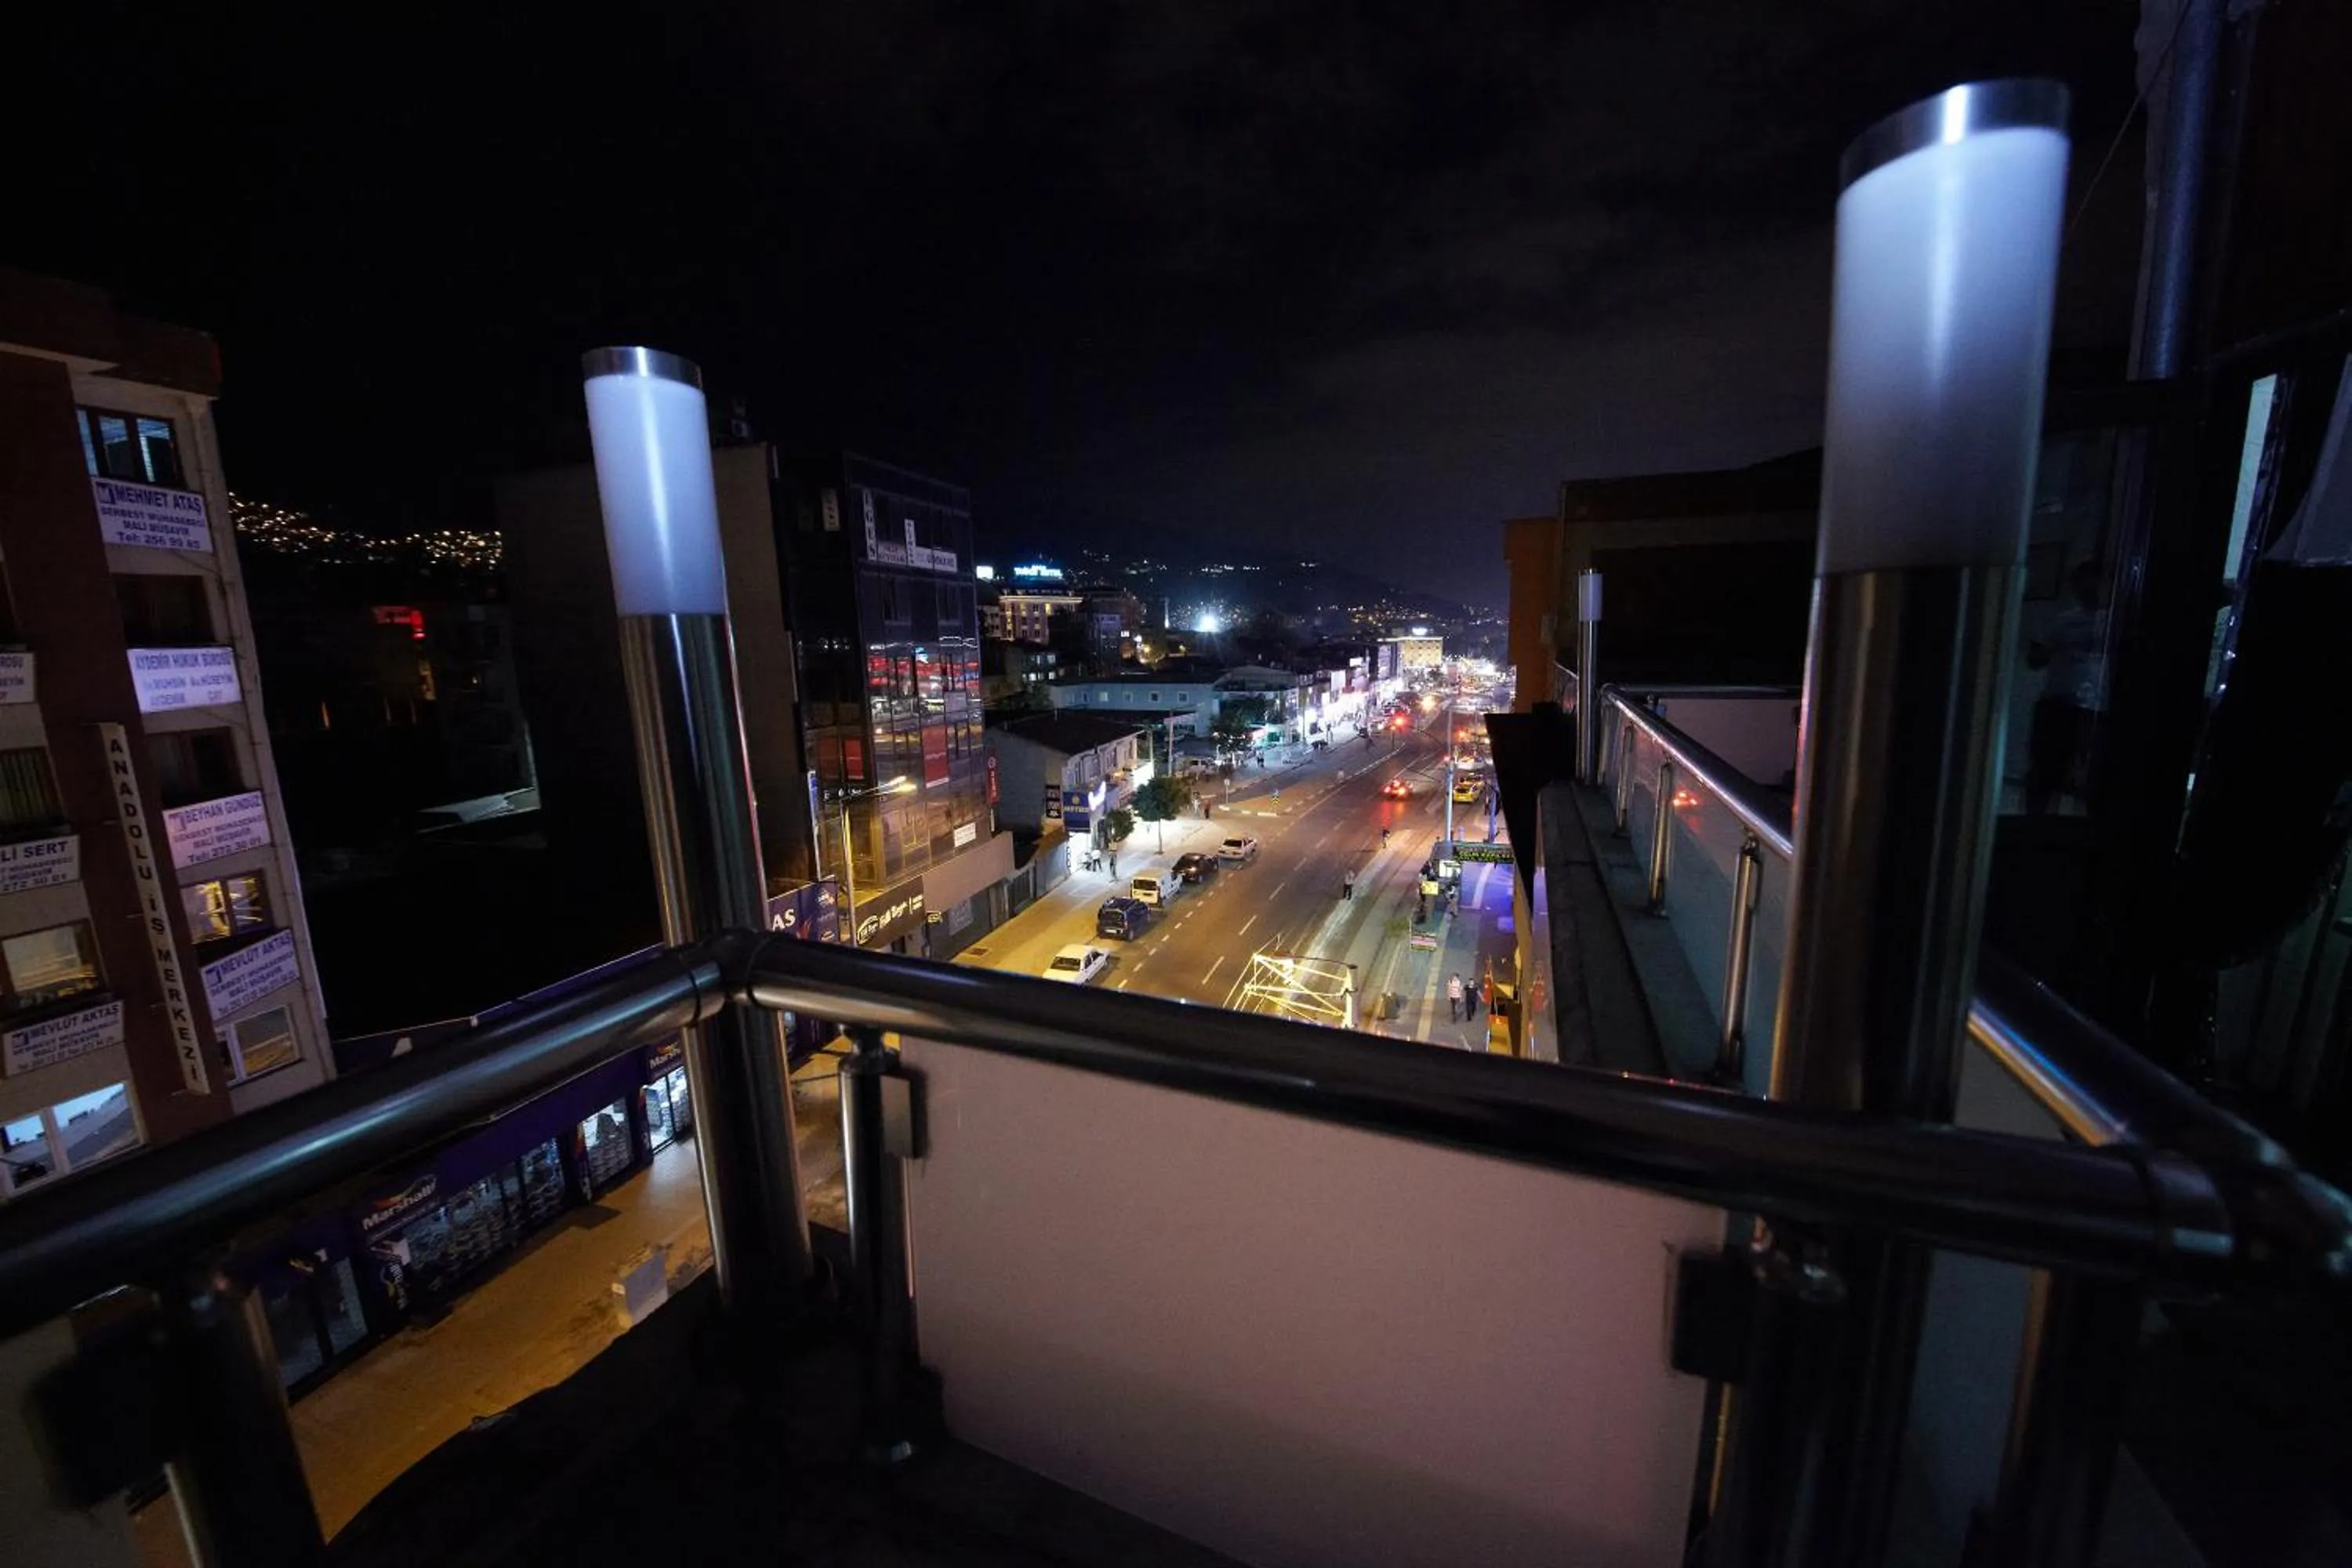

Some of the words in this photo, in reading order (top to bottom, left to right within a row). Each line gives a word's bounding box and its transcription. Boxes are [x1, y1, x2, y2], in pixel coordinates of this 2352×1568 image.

[114, 484, 168, 508] MEHMET
[111, 739, 152, 880] ANADOLU
[24, 840, 69, 858] SERT
